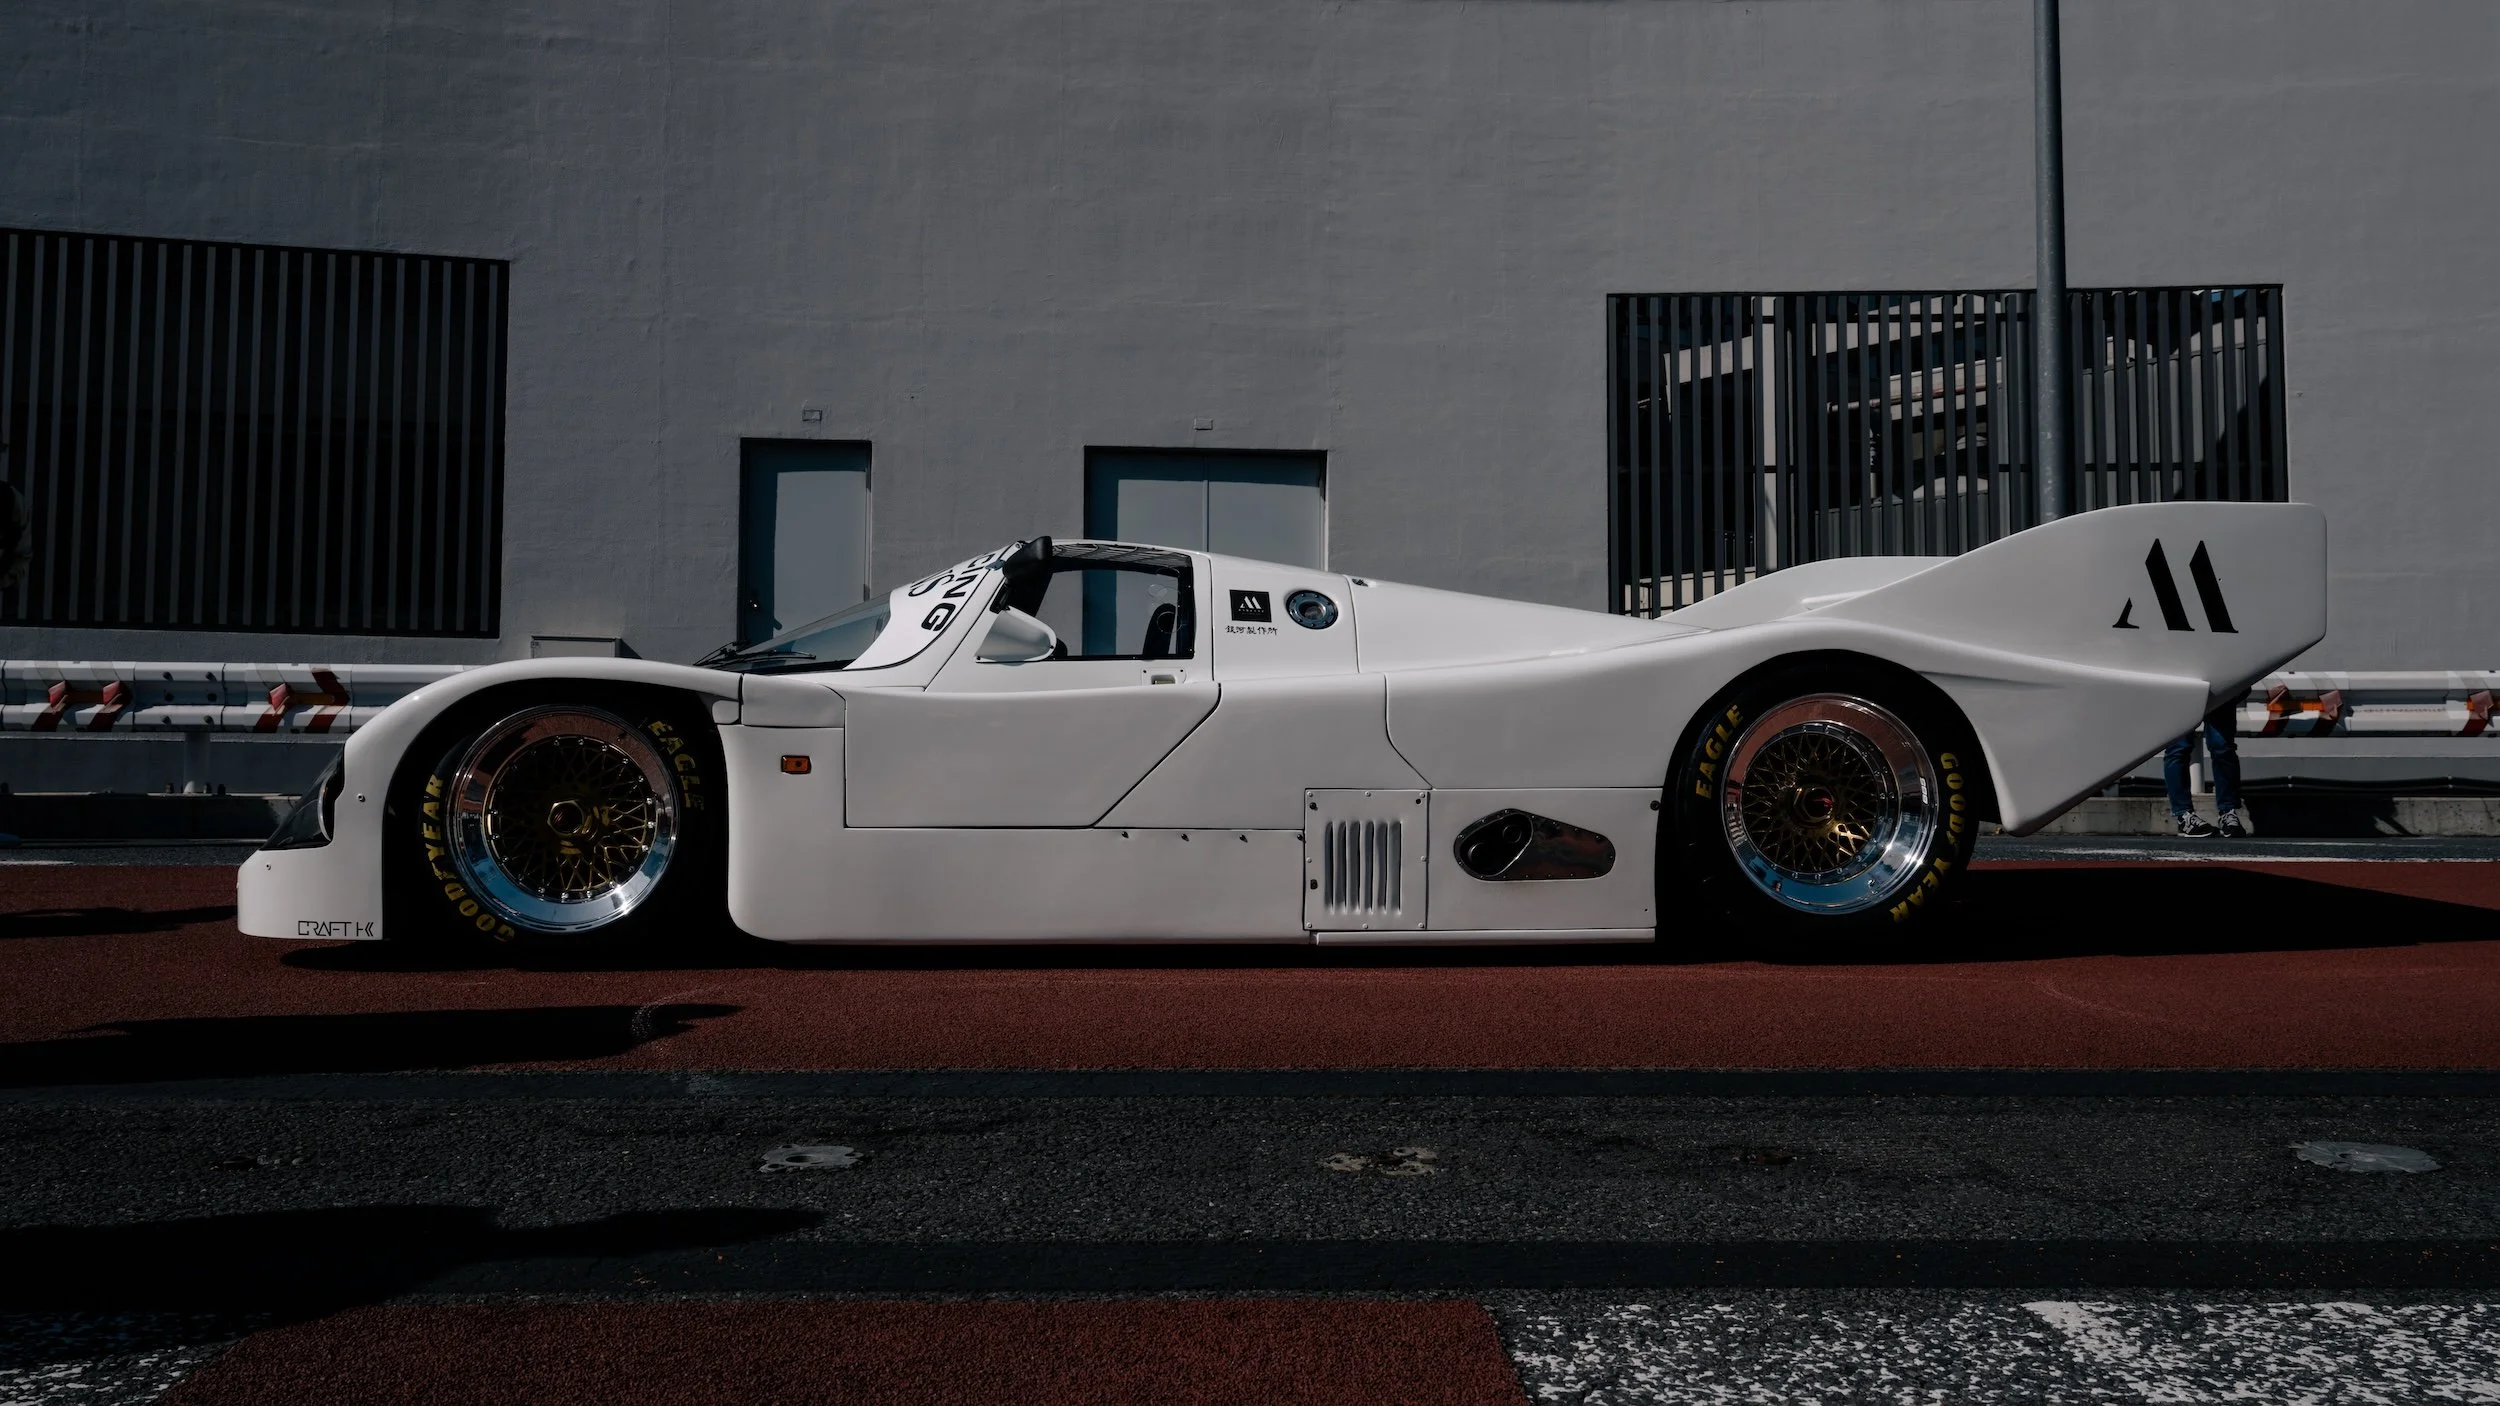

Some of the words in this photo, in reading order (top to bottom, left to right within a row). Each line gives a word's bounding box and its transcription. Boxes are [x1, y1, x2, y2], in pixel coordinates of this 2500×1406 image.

[647, 720, 705, 811] EAGLE
[1695, 704, 1745, 801] EAGLE
[297, 920, 352, 937] CRAFT
